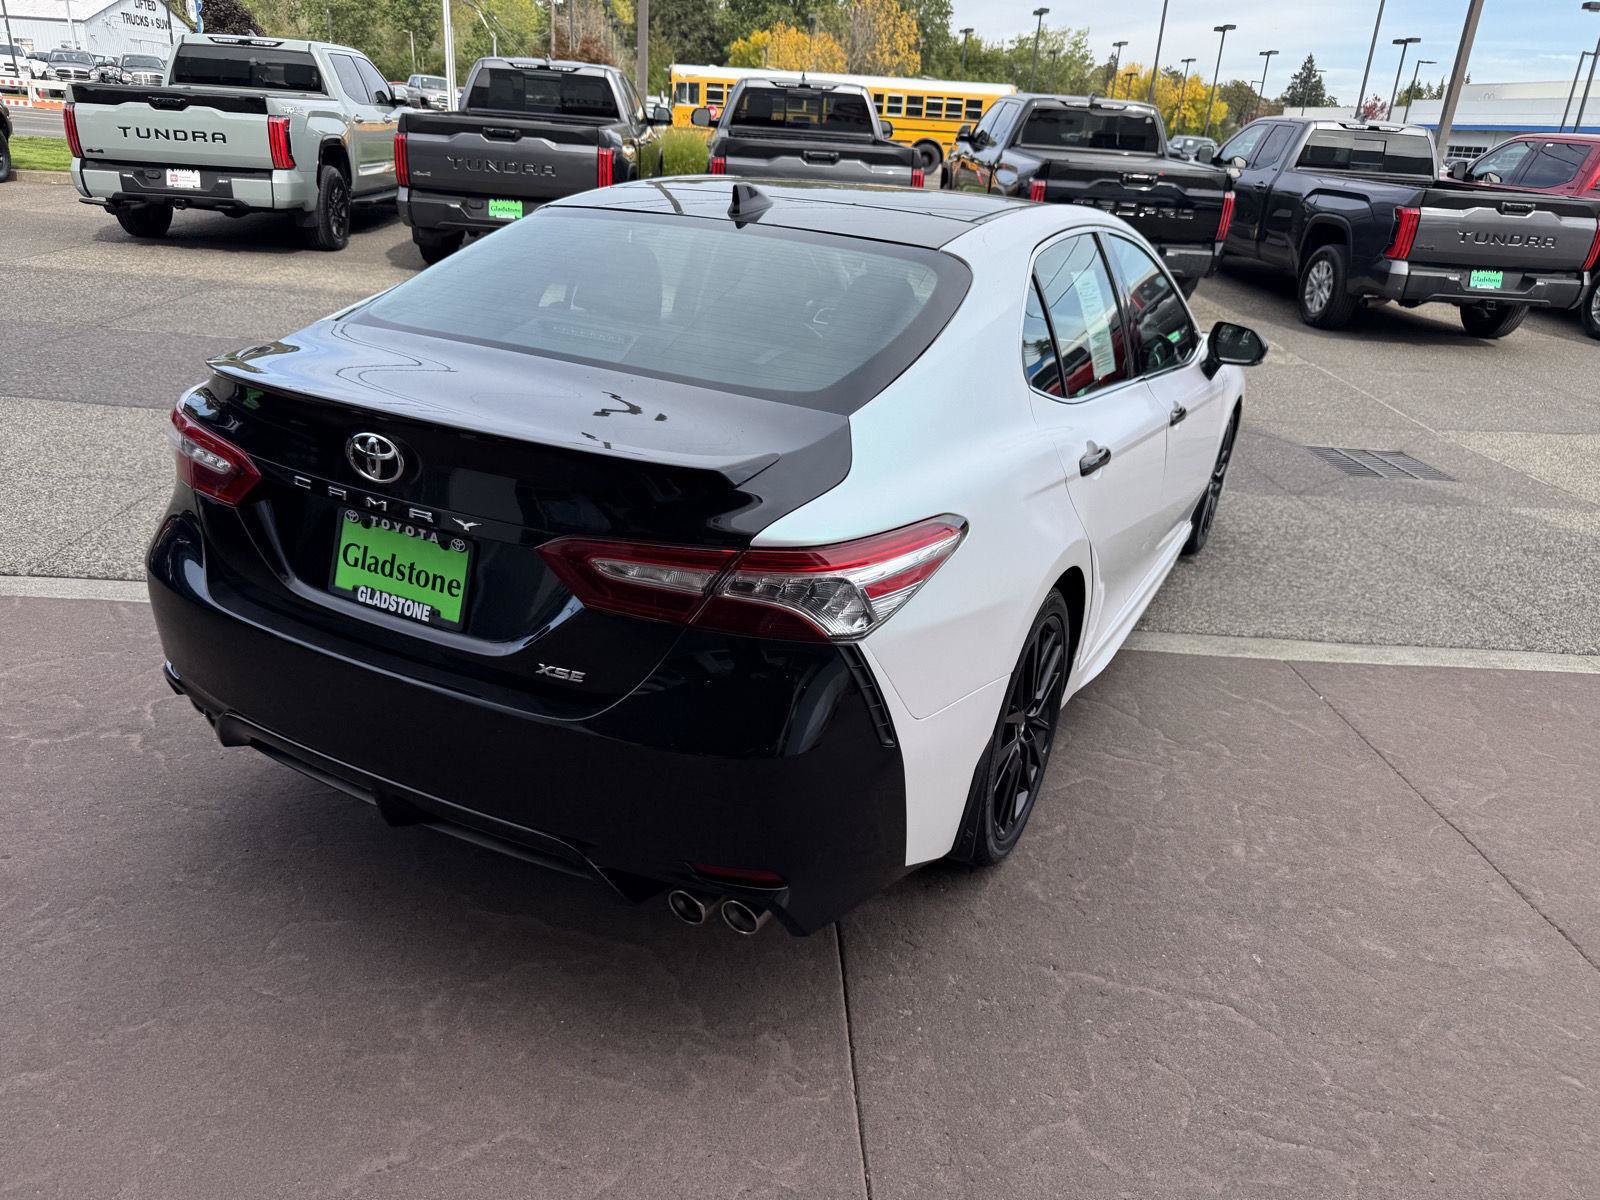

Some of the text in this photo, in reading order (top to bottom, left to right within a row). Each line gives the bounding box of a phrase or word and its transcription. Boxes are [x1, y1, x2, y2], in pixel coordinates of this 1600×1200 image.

[134, 0, 157, 12] LIFTED
[121, 12, 149, 27] TRUCKS
[117, 126, 227, 144] TUNDRA
[446, 155, 557, 177] TUNDRA
[1457, 230, 1557, 249] TUNDRA
[293, 474, 483, 532] CAMRY
[370, 514, 440, 544] TOYOTA
[342, 542, 462, 598] Gladstone
[357, 585, 432, 623] GLADSTONE
[535, 662, 587, 683] XSE
